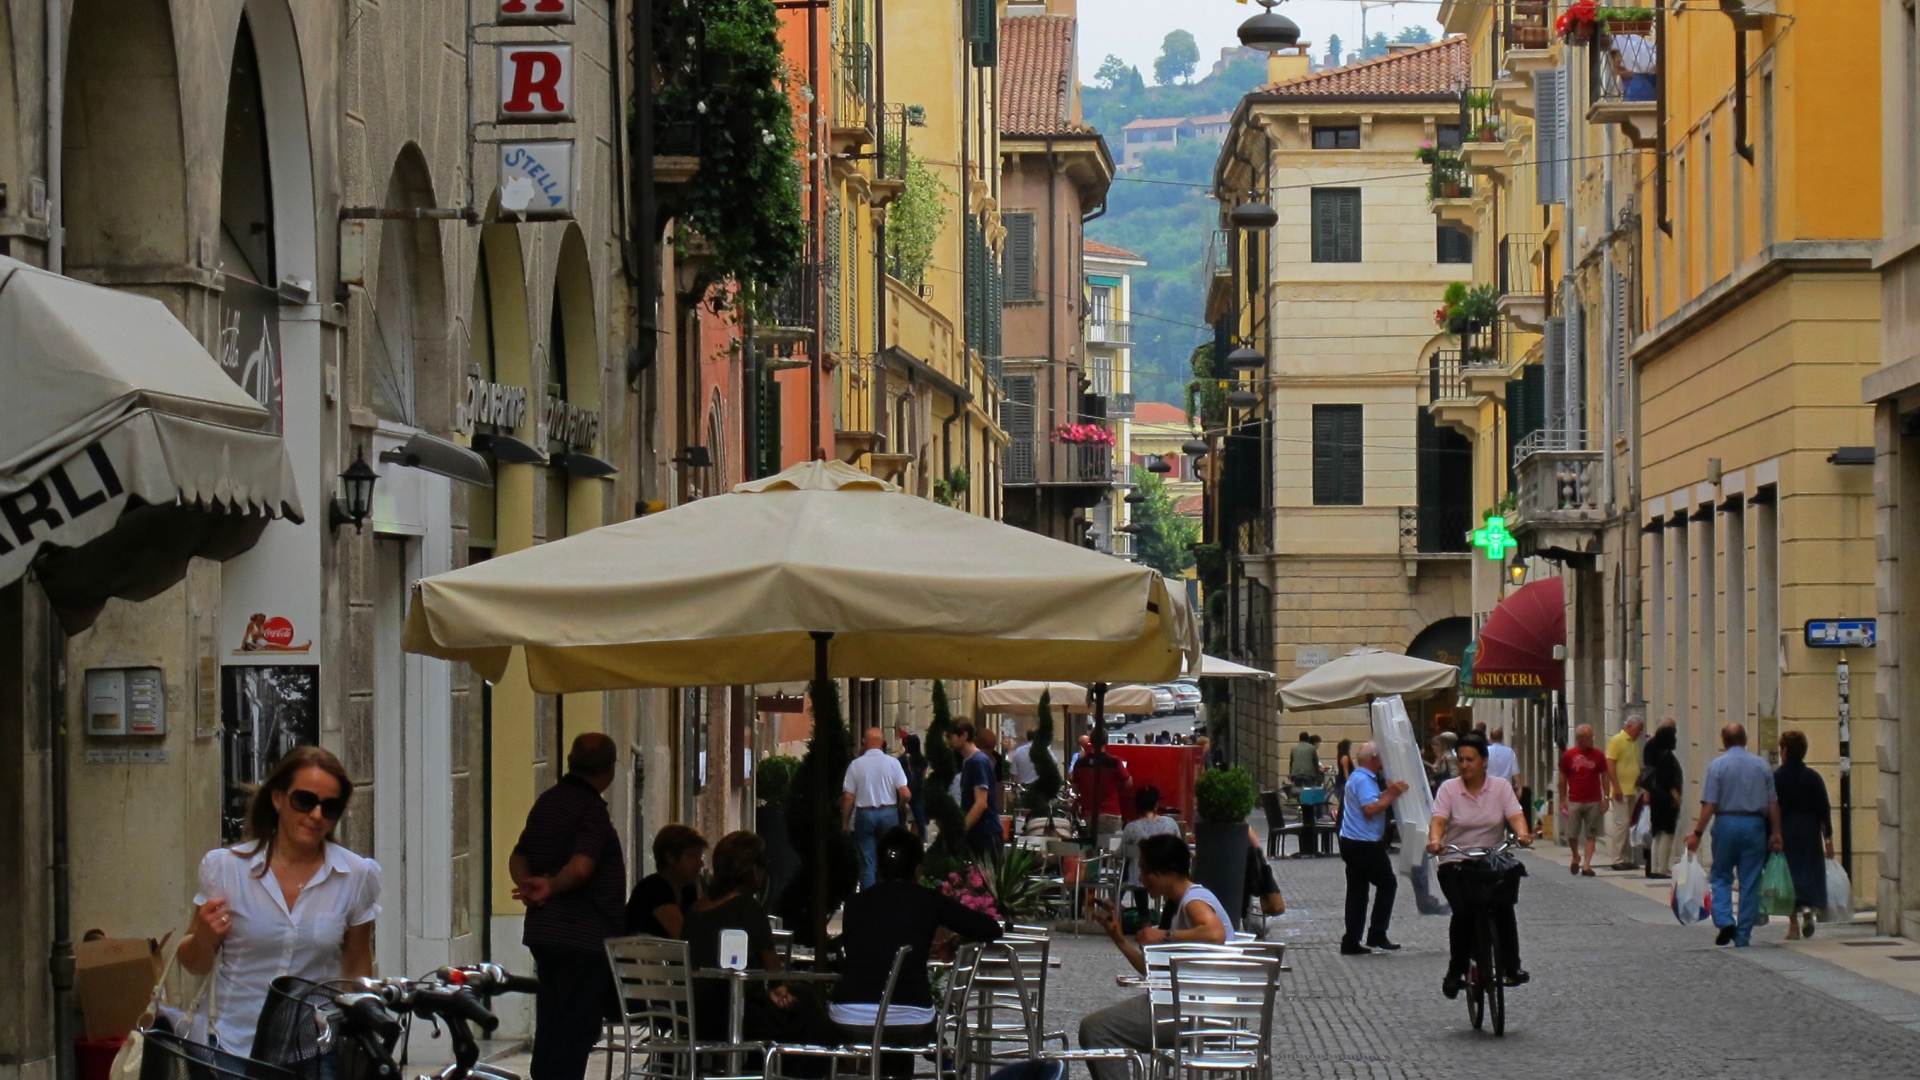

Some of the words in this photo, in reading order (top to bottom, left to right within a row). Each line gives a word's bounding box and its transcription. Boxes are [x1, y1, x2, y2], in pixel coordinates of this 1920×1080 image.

[505, 148, 563, 207] STELLA
[0, 442, 124, 553] RLI
[263, 627, 292, 638] Coca-Cola
[1476, 673, 1542, 686] PASTICCERIA
